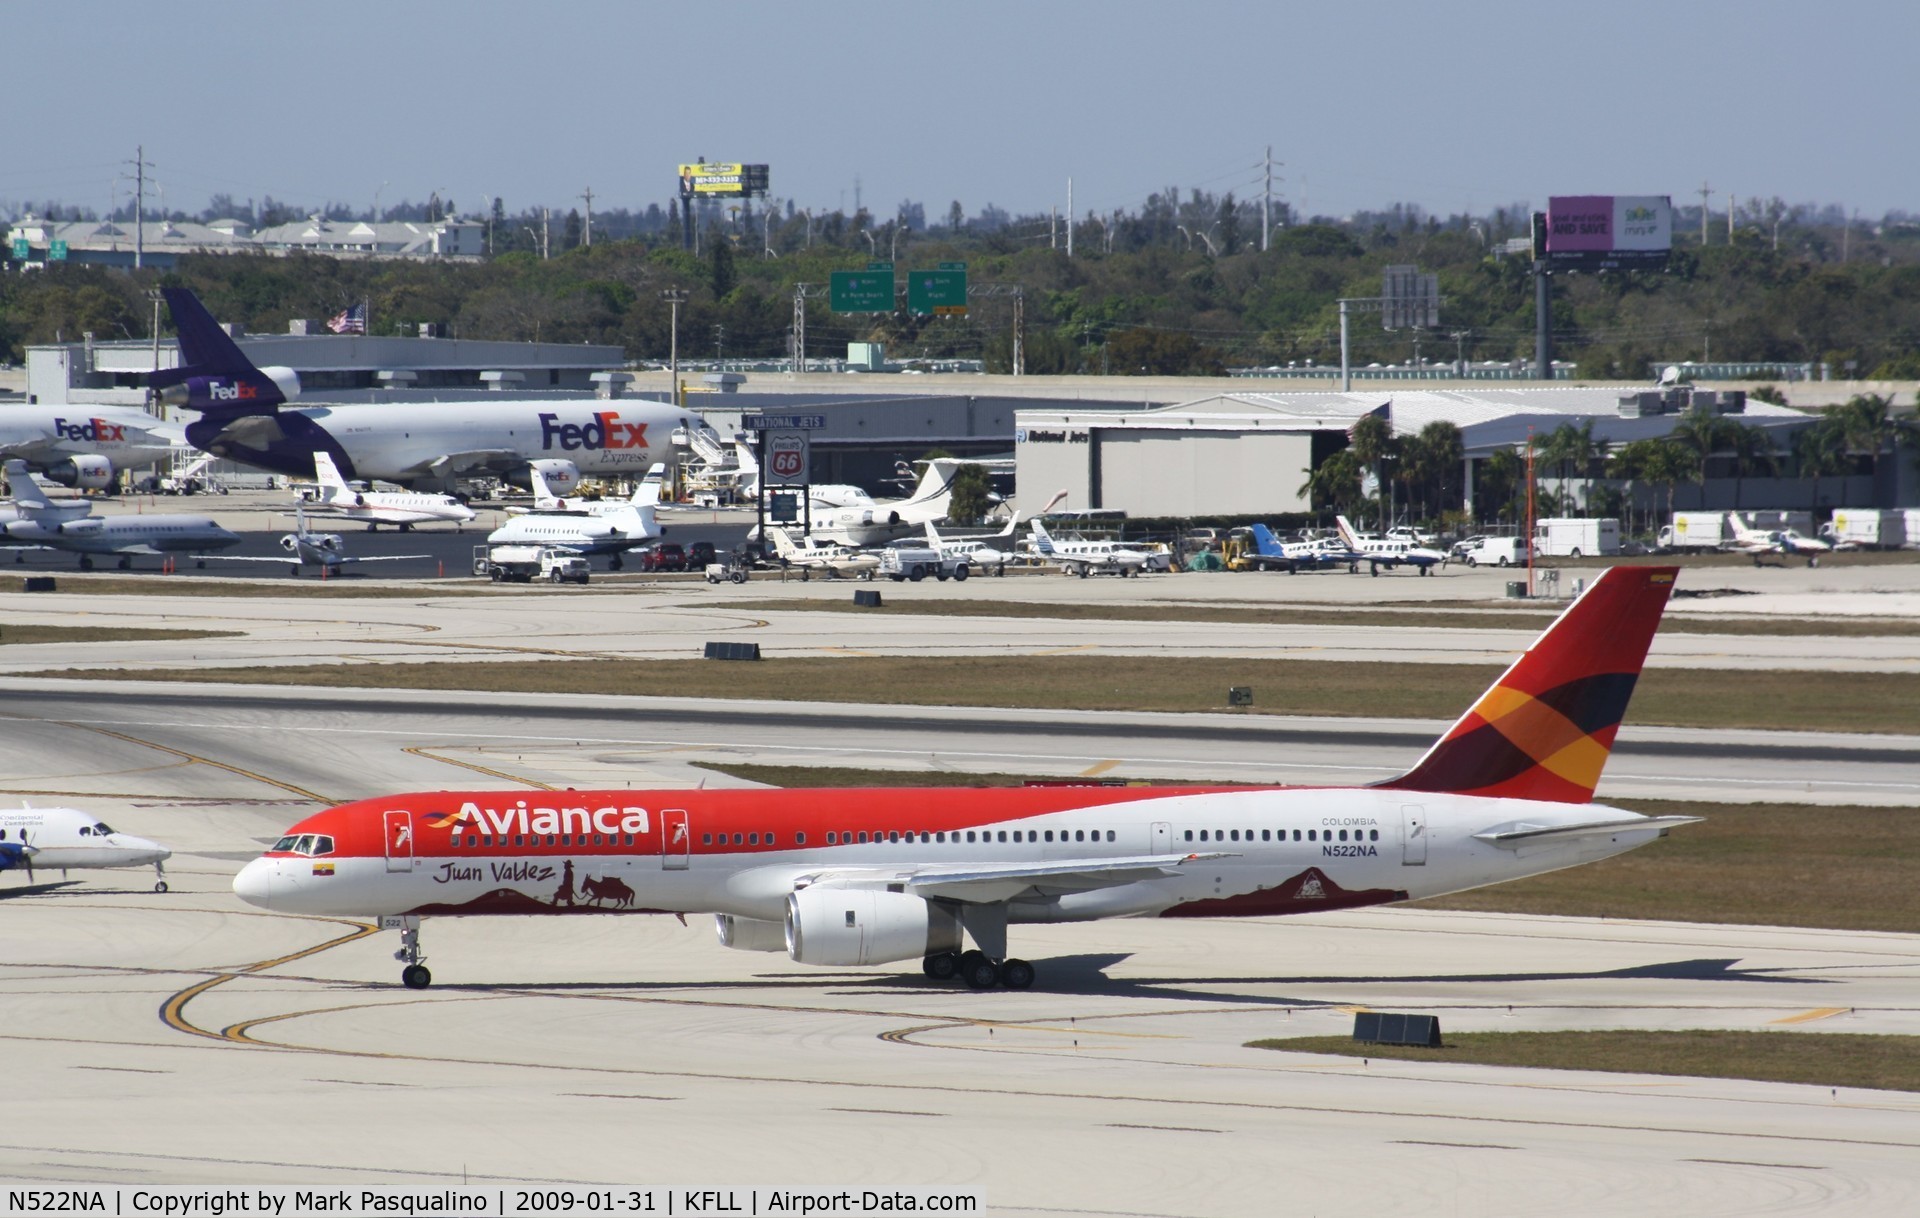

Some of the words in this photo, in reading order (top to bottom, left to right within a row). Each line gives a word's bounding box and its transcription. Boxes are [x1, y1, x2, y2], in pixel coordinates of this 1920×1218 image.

[1553, 223, 1577, 235] AND
[209, 381, 258, 400] FedEx
[754, 415, 794, 428] NATIONAL
[798, 415, 820, 427] JETS
[54, 418, 125, 441] FedEx
[538, 411, 649, 451] FedEx
[600, 450, 649, 465] Express
[776, 453, 798, 470] 66
[83, 467, 106, 477] FedEx
[545, 471, 569, 481] FedEx
[452, 801, 650, 835] Avianca
[1322, 817, 1377, 826] COLOMBIA
[1322, 845, 1378, 857] N522NA
[433, 861, 482, 884] Juan
[491, 861, 556, 883] Valdez
[385, 919, 401, 927] 522
